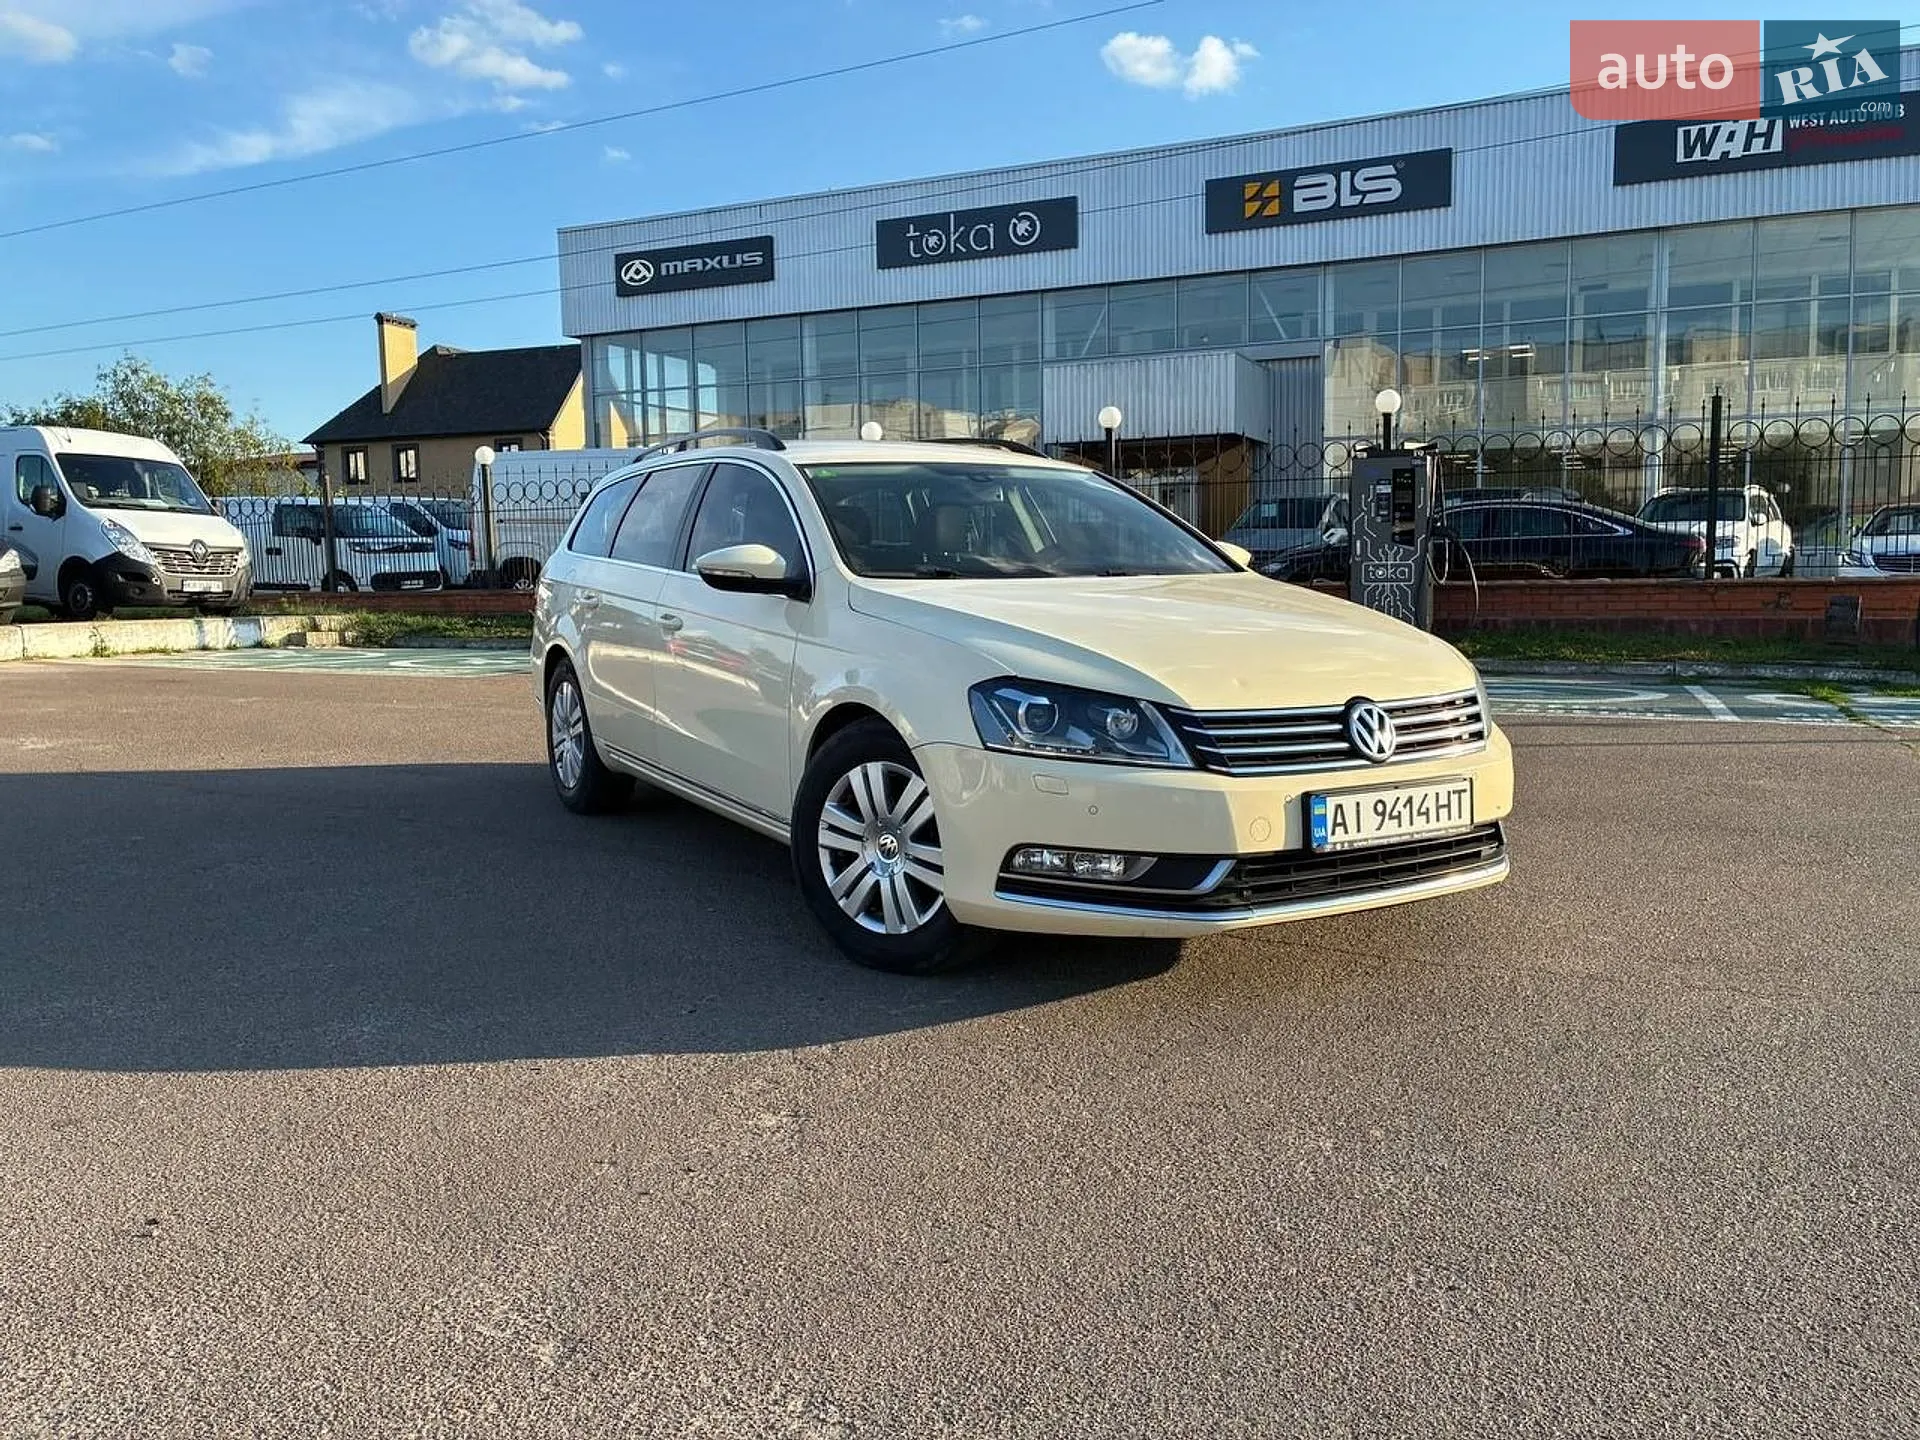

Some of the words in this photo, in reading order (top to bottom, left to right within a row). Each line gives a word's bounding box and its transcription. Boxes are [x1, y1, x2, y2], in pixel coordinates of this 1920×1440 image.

[1789, 112, 1826, 129] WEST
[1829, 108, 1868, 126] AUTO
[1679, 119, 1779, 161] WAH
[1293, 164, 1402, 213] BLS
[907, 213, 995, 258] toka
[660, 251, 764, 277] MAXUS
[1367, 566, 1409, 579] toka
[1331, 801, 1361, 836] AI
